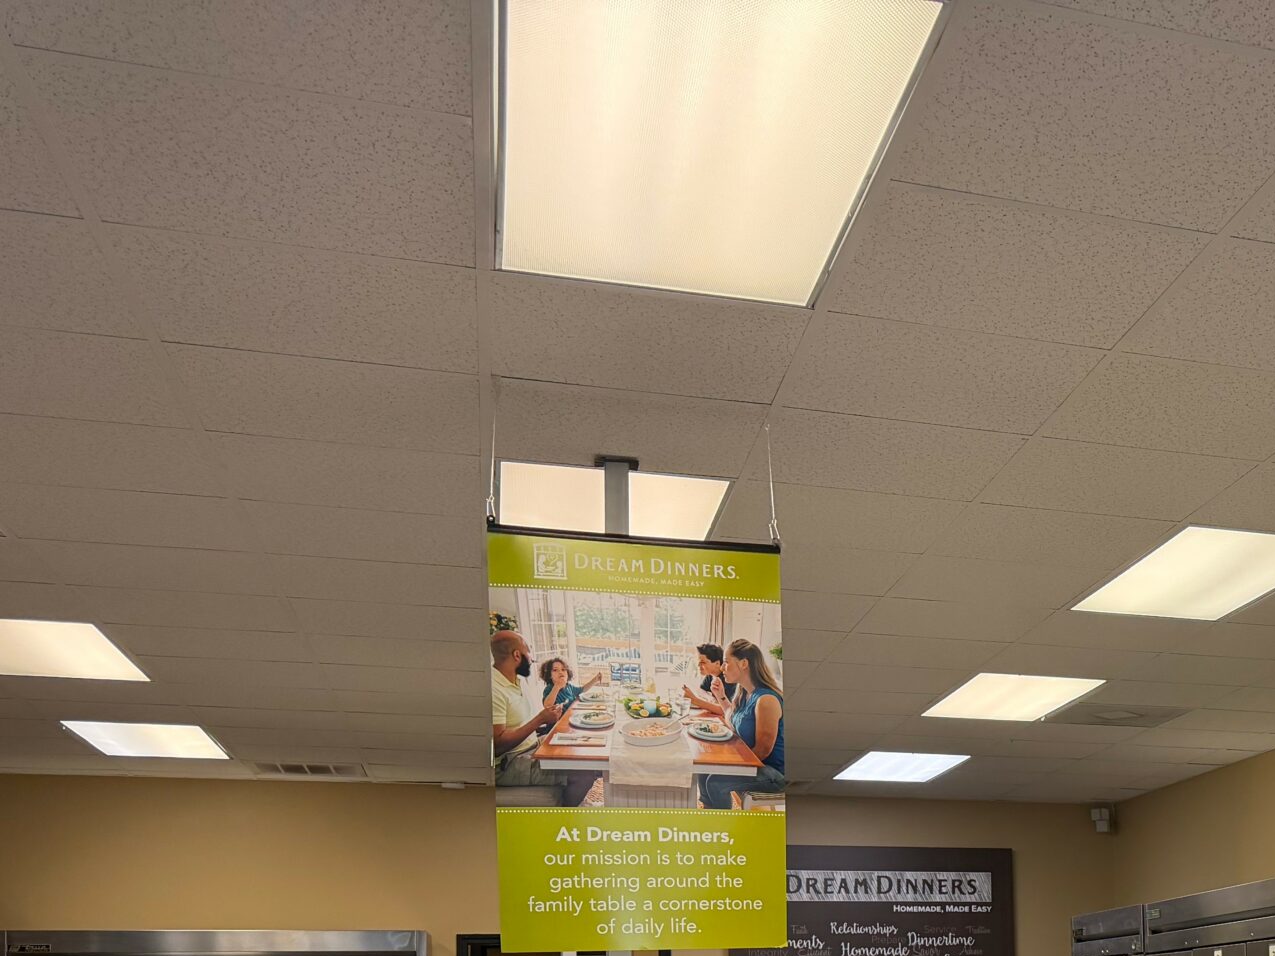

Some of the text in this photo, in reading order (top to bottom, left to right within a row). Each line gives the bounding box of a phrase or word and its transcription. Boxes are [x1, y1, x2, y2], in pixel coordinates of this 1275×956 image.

[574, 553, 644, 574] DREAM
[608, 576, 706, 588] HOMEMADE, MADE EASY
[555, 826, 735, 845] At Dream Dinners,
[544, 850, 747, 866] our mission is to make
[549, 873, 743, 892] gathering around the
[786, 874, 978, 895] DREAM DINNERS
[528, 896, 763, 916] family table a cornerstone
[893, 905, 992, 913] HOMEMADE, MADE EASY
[596, 918, 703, 938] of daily life.
[830, 922, 898, 937] Relationships
[907, 931, 975, 947] Dinnertime
